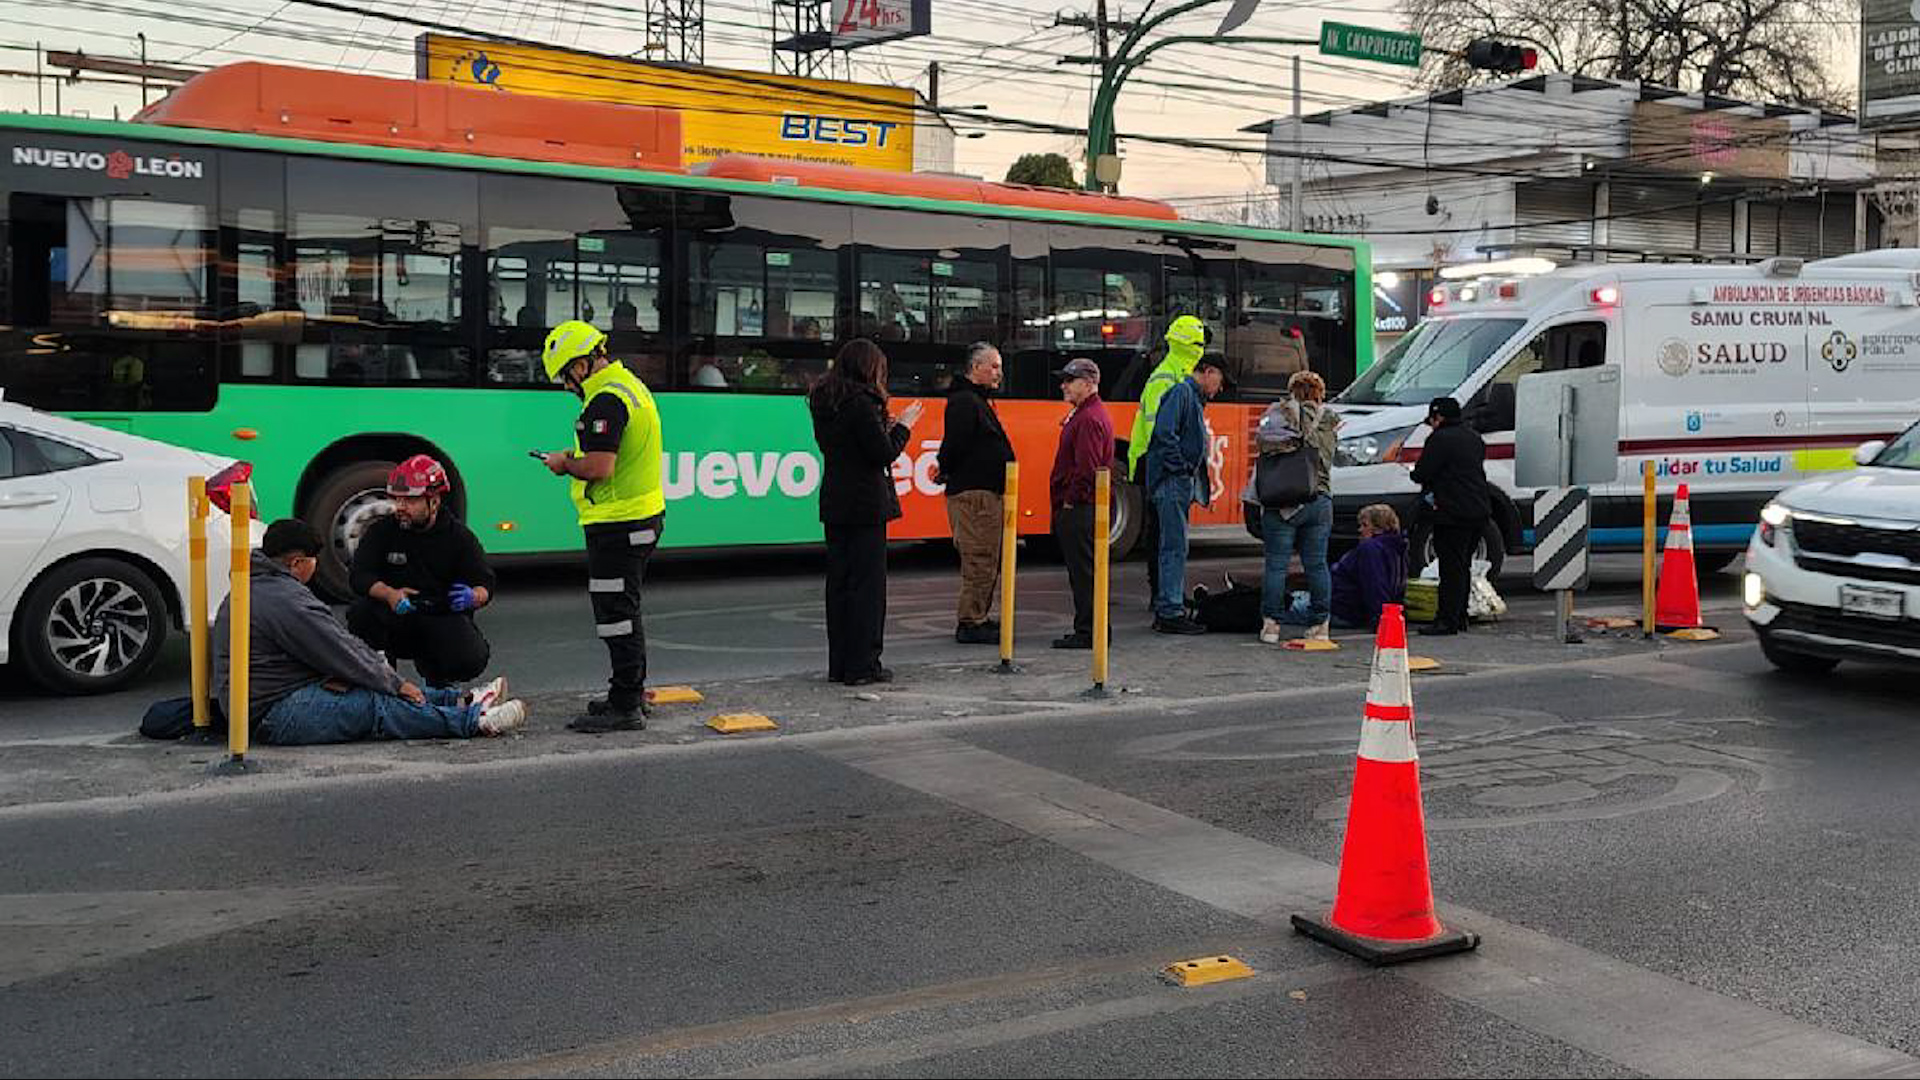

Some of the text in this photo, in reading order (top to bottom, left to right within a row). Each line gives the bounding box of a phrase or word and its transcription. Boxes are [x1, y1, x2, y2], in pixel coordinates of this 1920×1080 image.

[882, 8, 905, 25] hrs.
[1346, 32, 1417, 60] CHAPULTEPEC
[1874, 46, 1895, 61] DE
[780, 112, 897, 147] BEST
[12, 146, 203, 178] NUEVO LEÓN
[1713, 286, 1775, 302] AMBULANCIA
[1777, 286, 1790, 302] DE
[1792, 287, 1845, 302] URGENCIAS
[1691, 311, 1832, 326] SAMU CRUM NL
[1697, 343, 1787, 364] SALUD
[1705, 459, 1726, 474] tu
[1730, 456, 1781, 474] Salud
[660, 450, 821, 500] uevo
